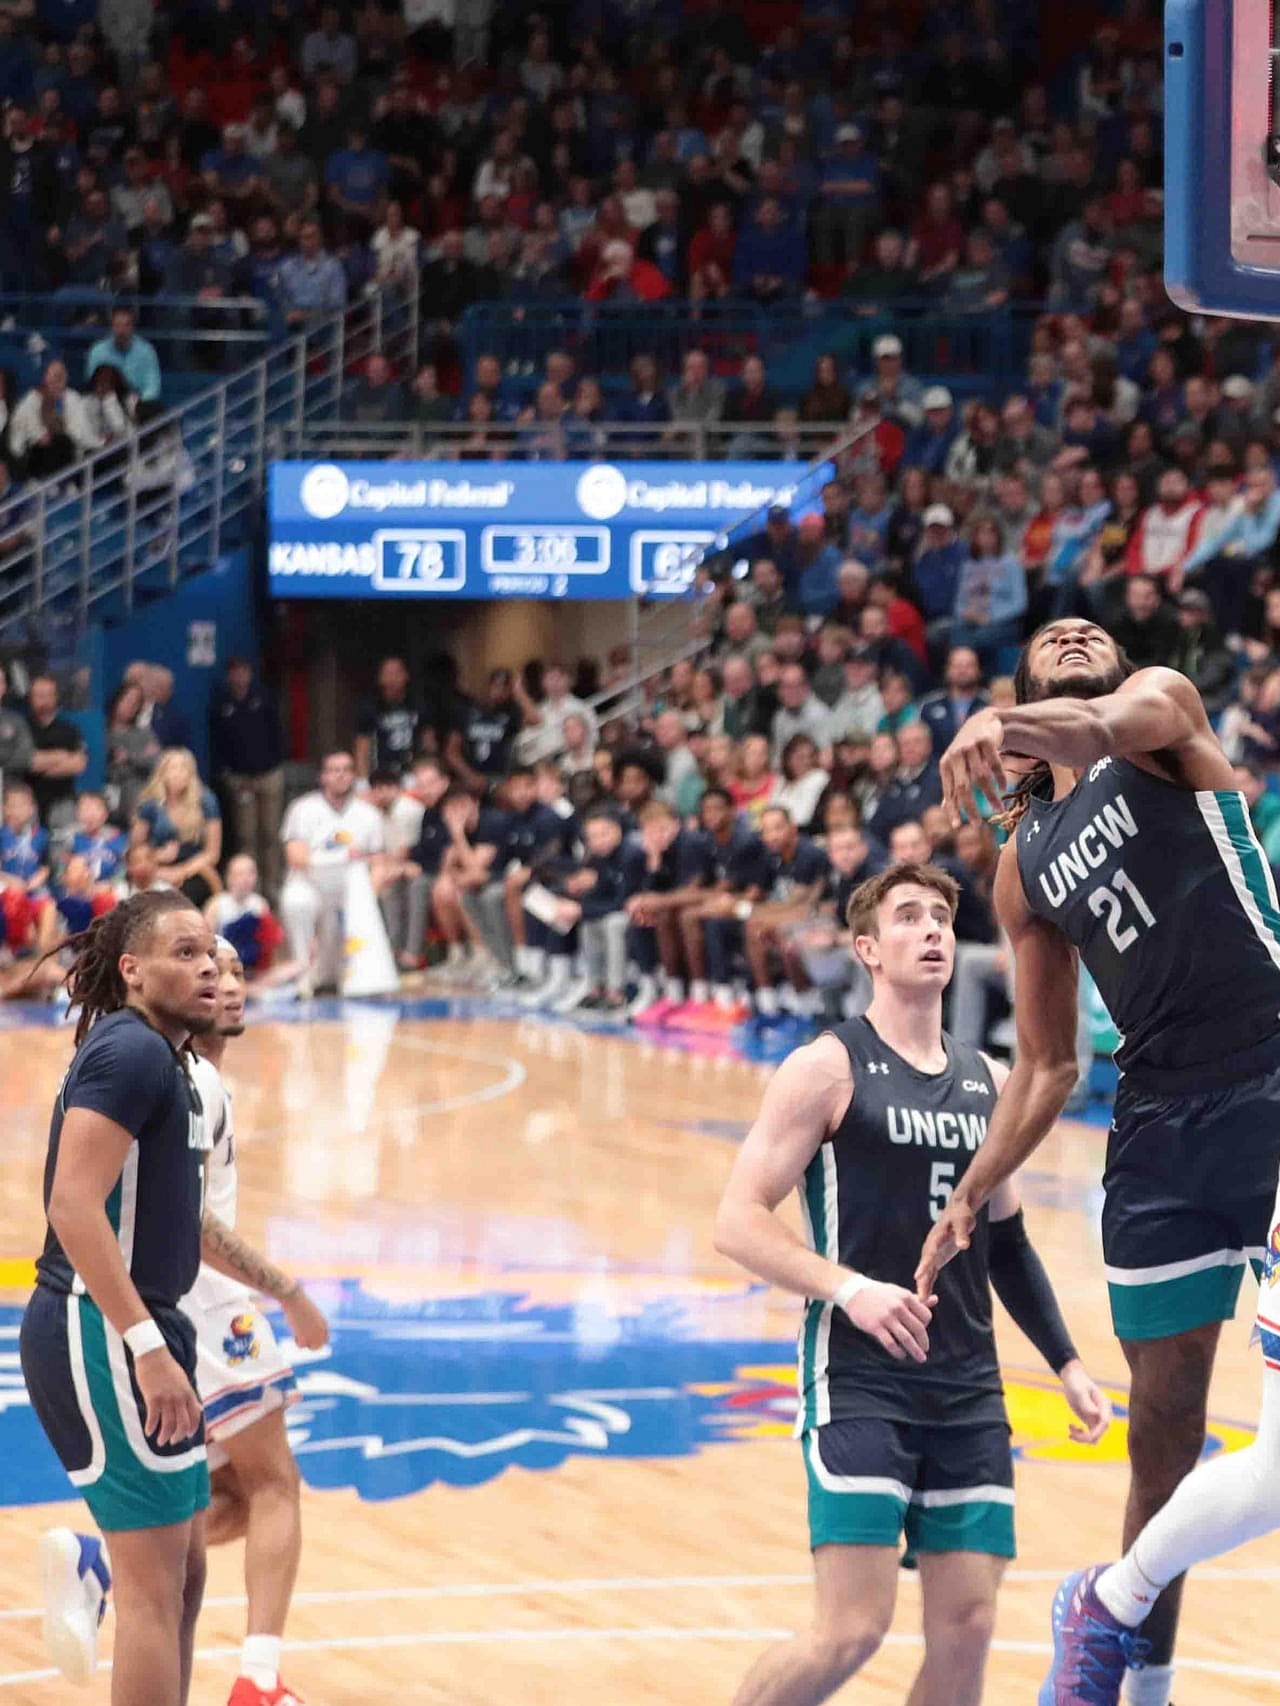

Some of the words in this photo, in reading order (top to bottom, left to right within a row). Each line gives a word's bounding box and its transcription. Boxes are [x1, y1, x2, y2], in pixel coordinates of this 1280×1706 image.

[269, 542, 376, 576] KANSAS
[1038, 794, 1139, 908] UNCW
[1087, 868, 1157, 954] 21
[886, 1105, 988, 1151] UNCW
[928, 1161, 955, 1223] 5
